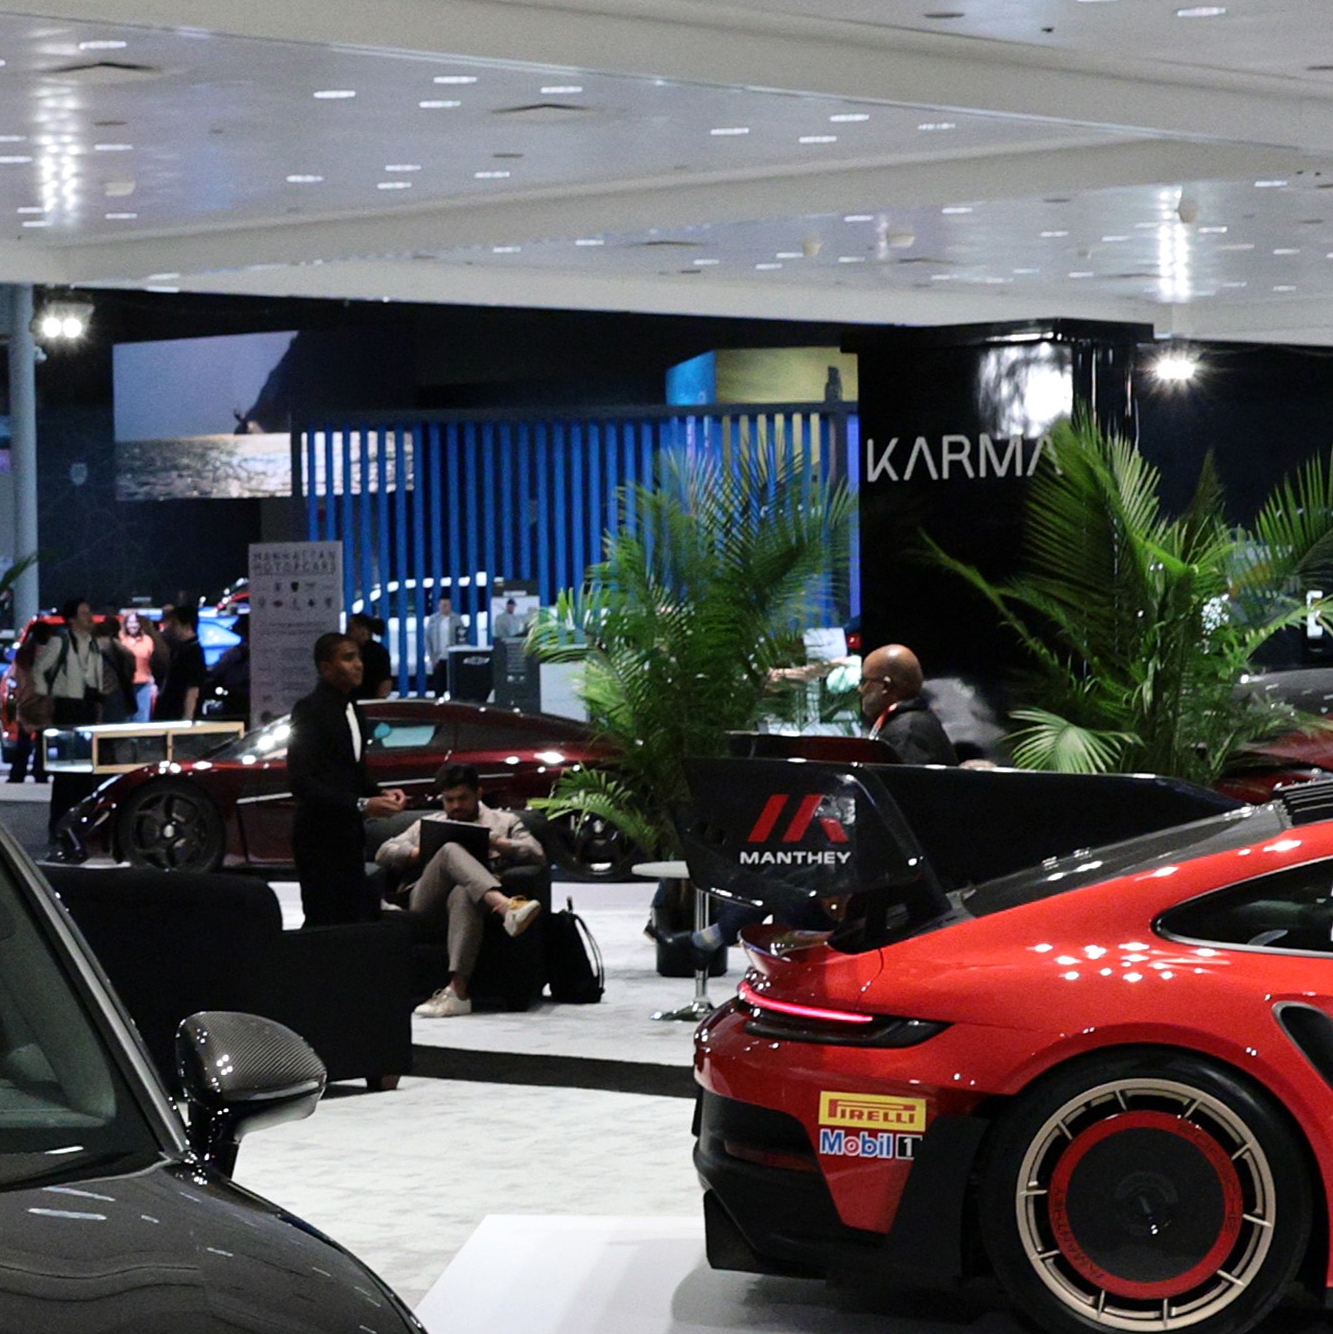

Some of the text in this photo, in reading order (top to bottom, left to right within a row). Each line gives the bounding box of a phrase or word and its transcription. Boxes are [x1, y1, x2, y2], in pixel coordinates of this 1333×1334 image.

[867, 432, 1064, 483] KARMA
[740, 851, 851, 864] MANTHEY
[827, 1099, 917, 1124] PIRELLI
[819, 1128, 893, 1160] Mobil
